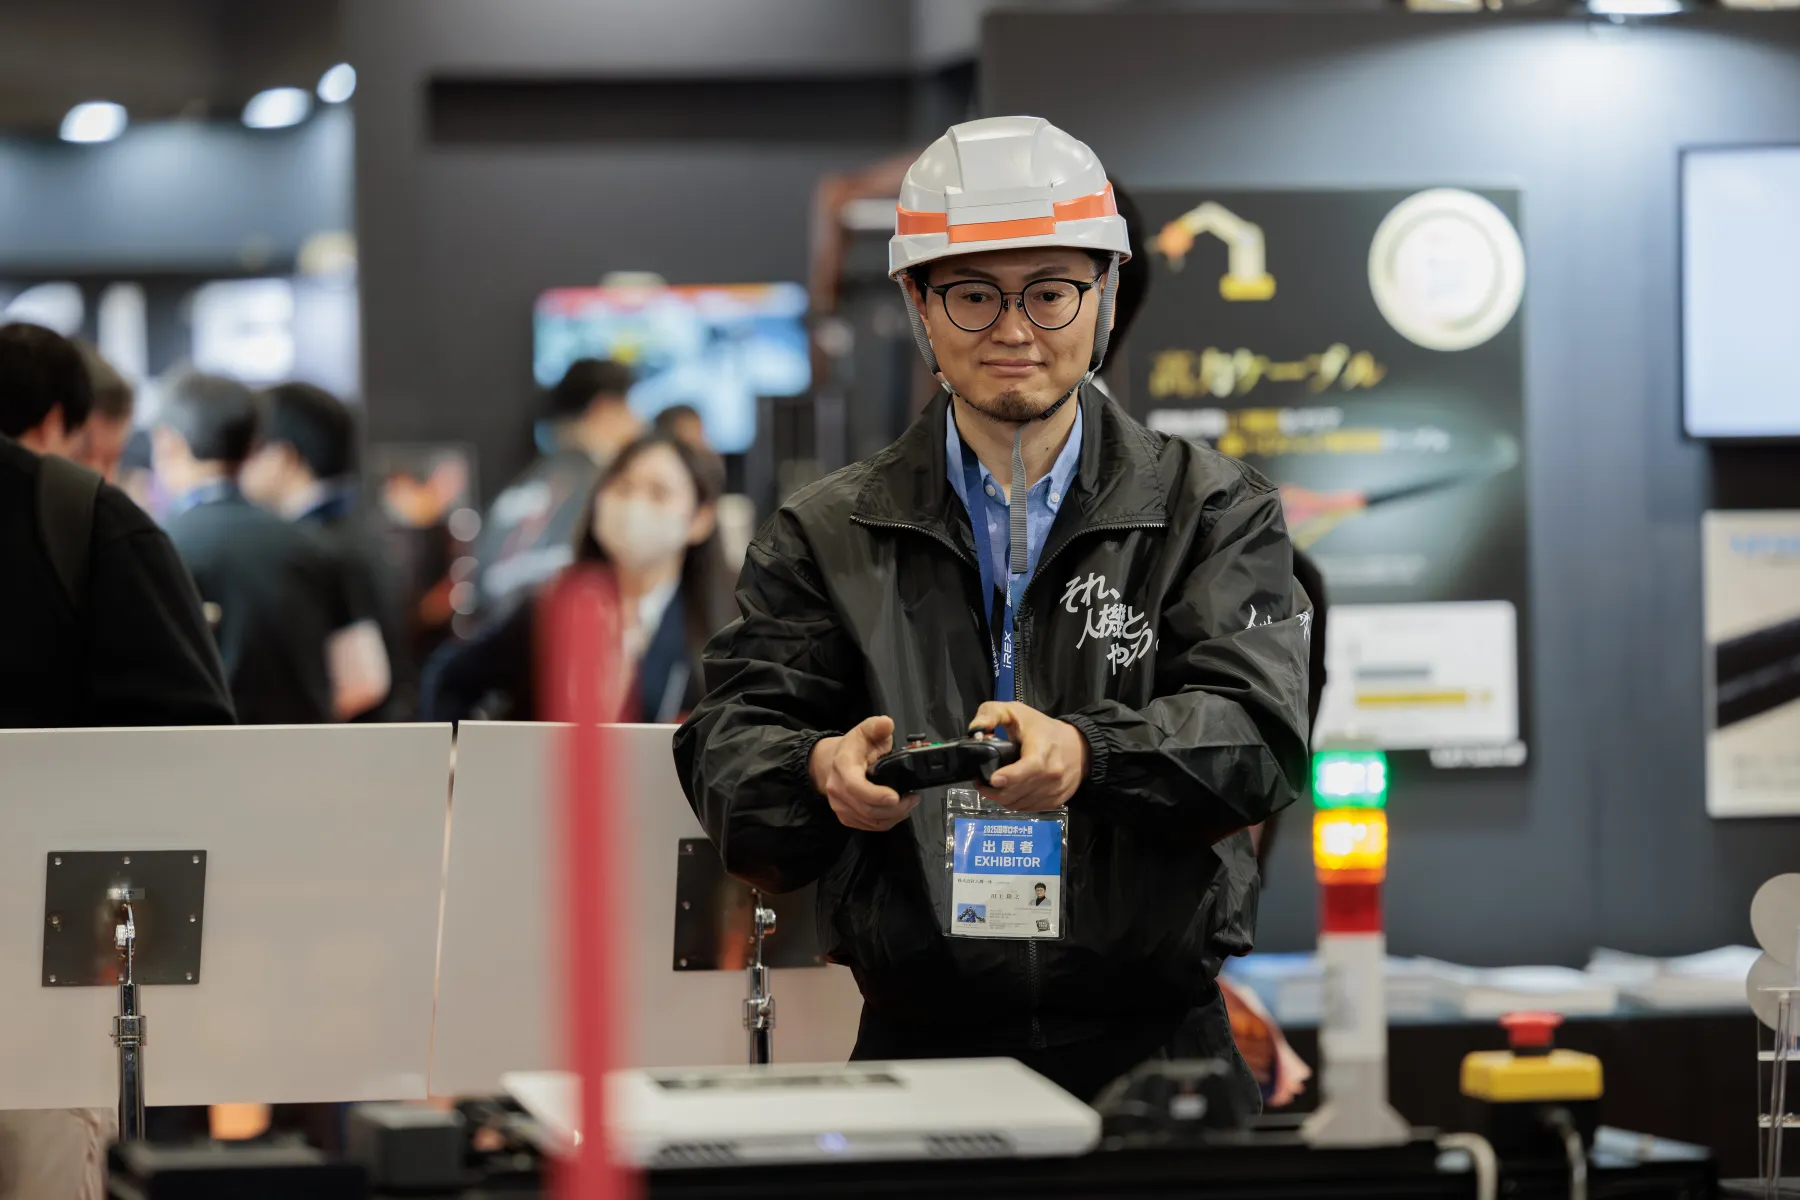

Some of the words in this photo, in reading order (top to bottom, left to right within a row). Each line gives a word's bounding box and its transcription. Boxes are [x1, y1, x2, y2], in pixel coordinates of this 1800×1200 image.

[1060, 572, 1121, 613] それ、
[1075, 603, 1145, 650] 人機と
[1003, 630, 1012, 669] iREX
[974, 855, 1041, 868] EXHIBITOR
[982, 840, 1034, 854] 出展者
